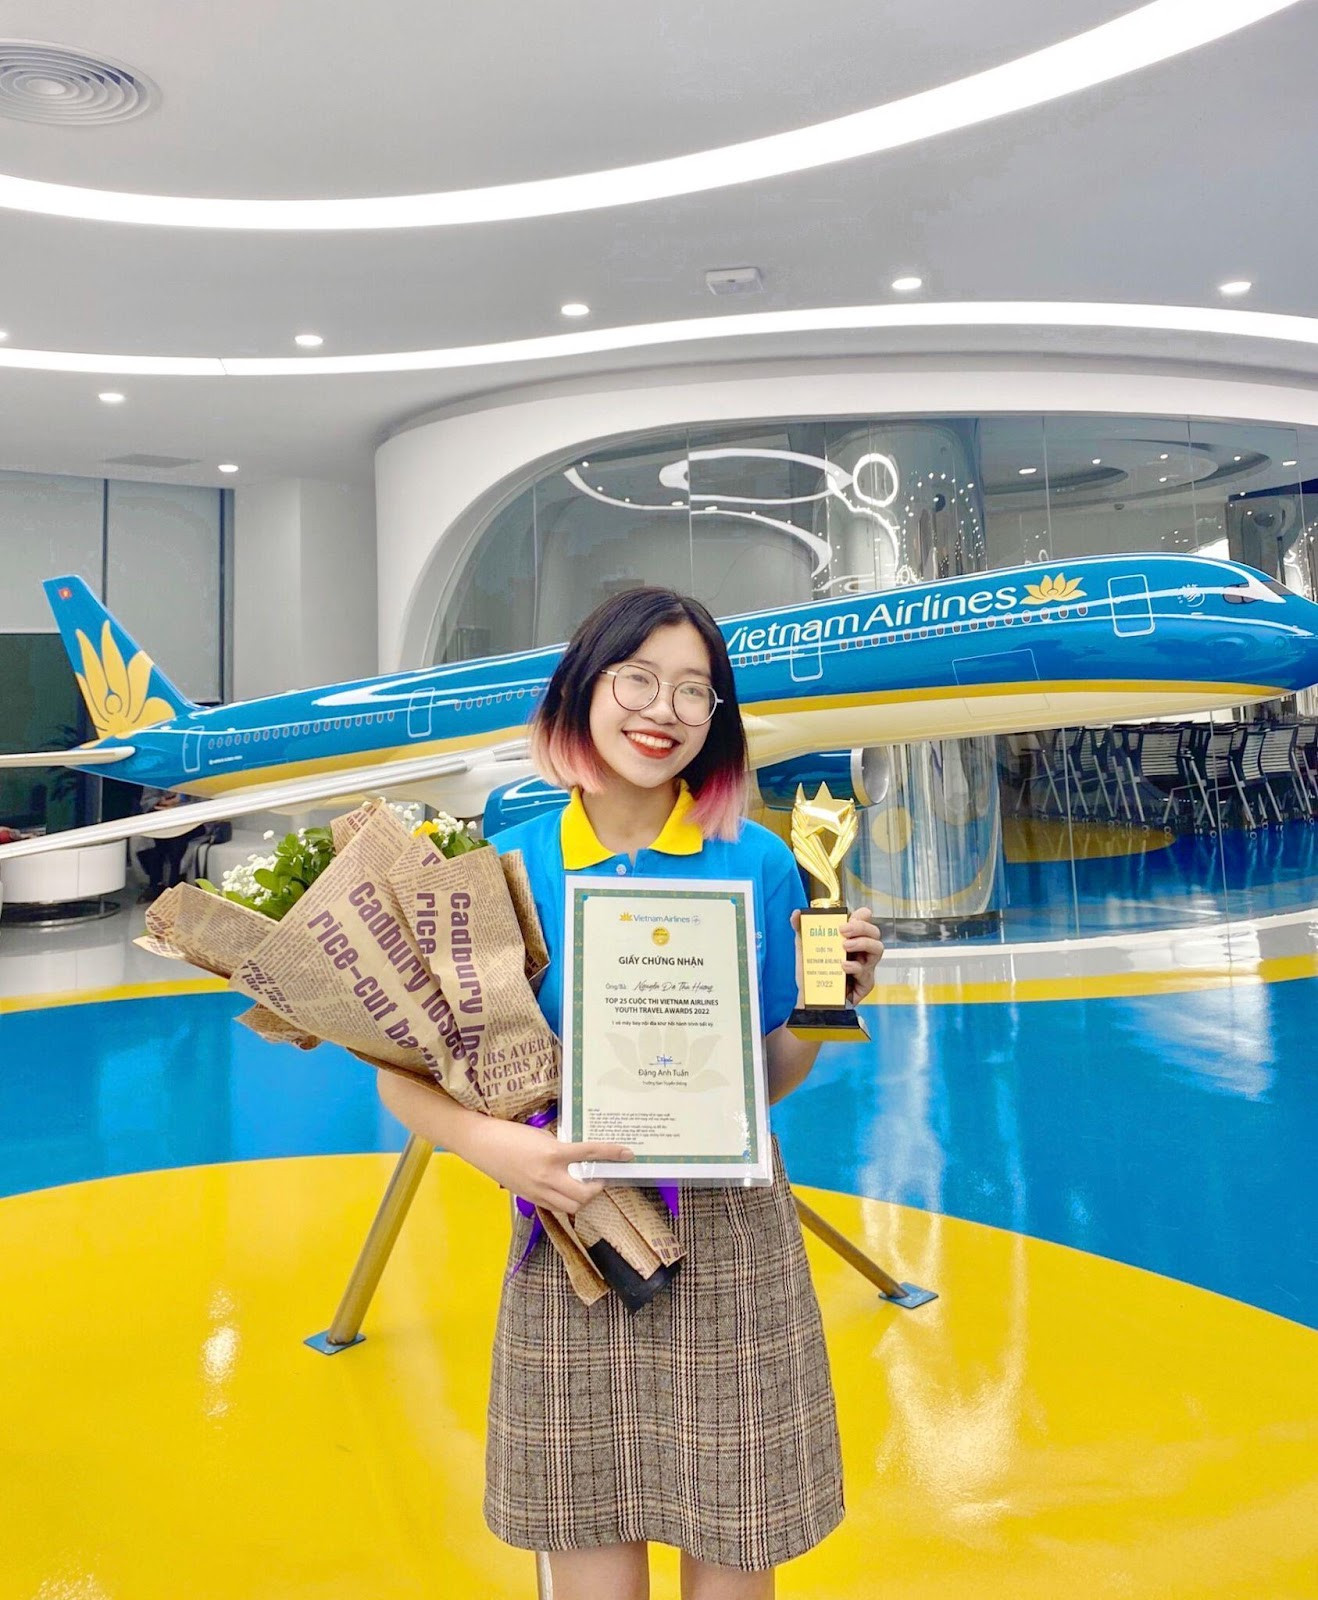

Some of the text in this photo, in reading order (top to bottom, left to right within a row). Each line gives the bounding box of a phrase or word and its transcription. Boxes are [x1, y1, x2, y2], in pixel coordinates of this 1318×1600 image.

[862, 585, 1018, 632] Airlines
[349, 881, 431, 993] Cadbury
[827, 927, 839, 937] BA
[307, 910, 399, 1022] rice-cut
[450, 892, 483, 1014] Cadbury
[605, 996, 618, 1004] TOP
[660, 998, 689, 1006] VIETNAM
[506, 1075, 526, 1092] OF
[657, 1068, 672, 1077] Anh
